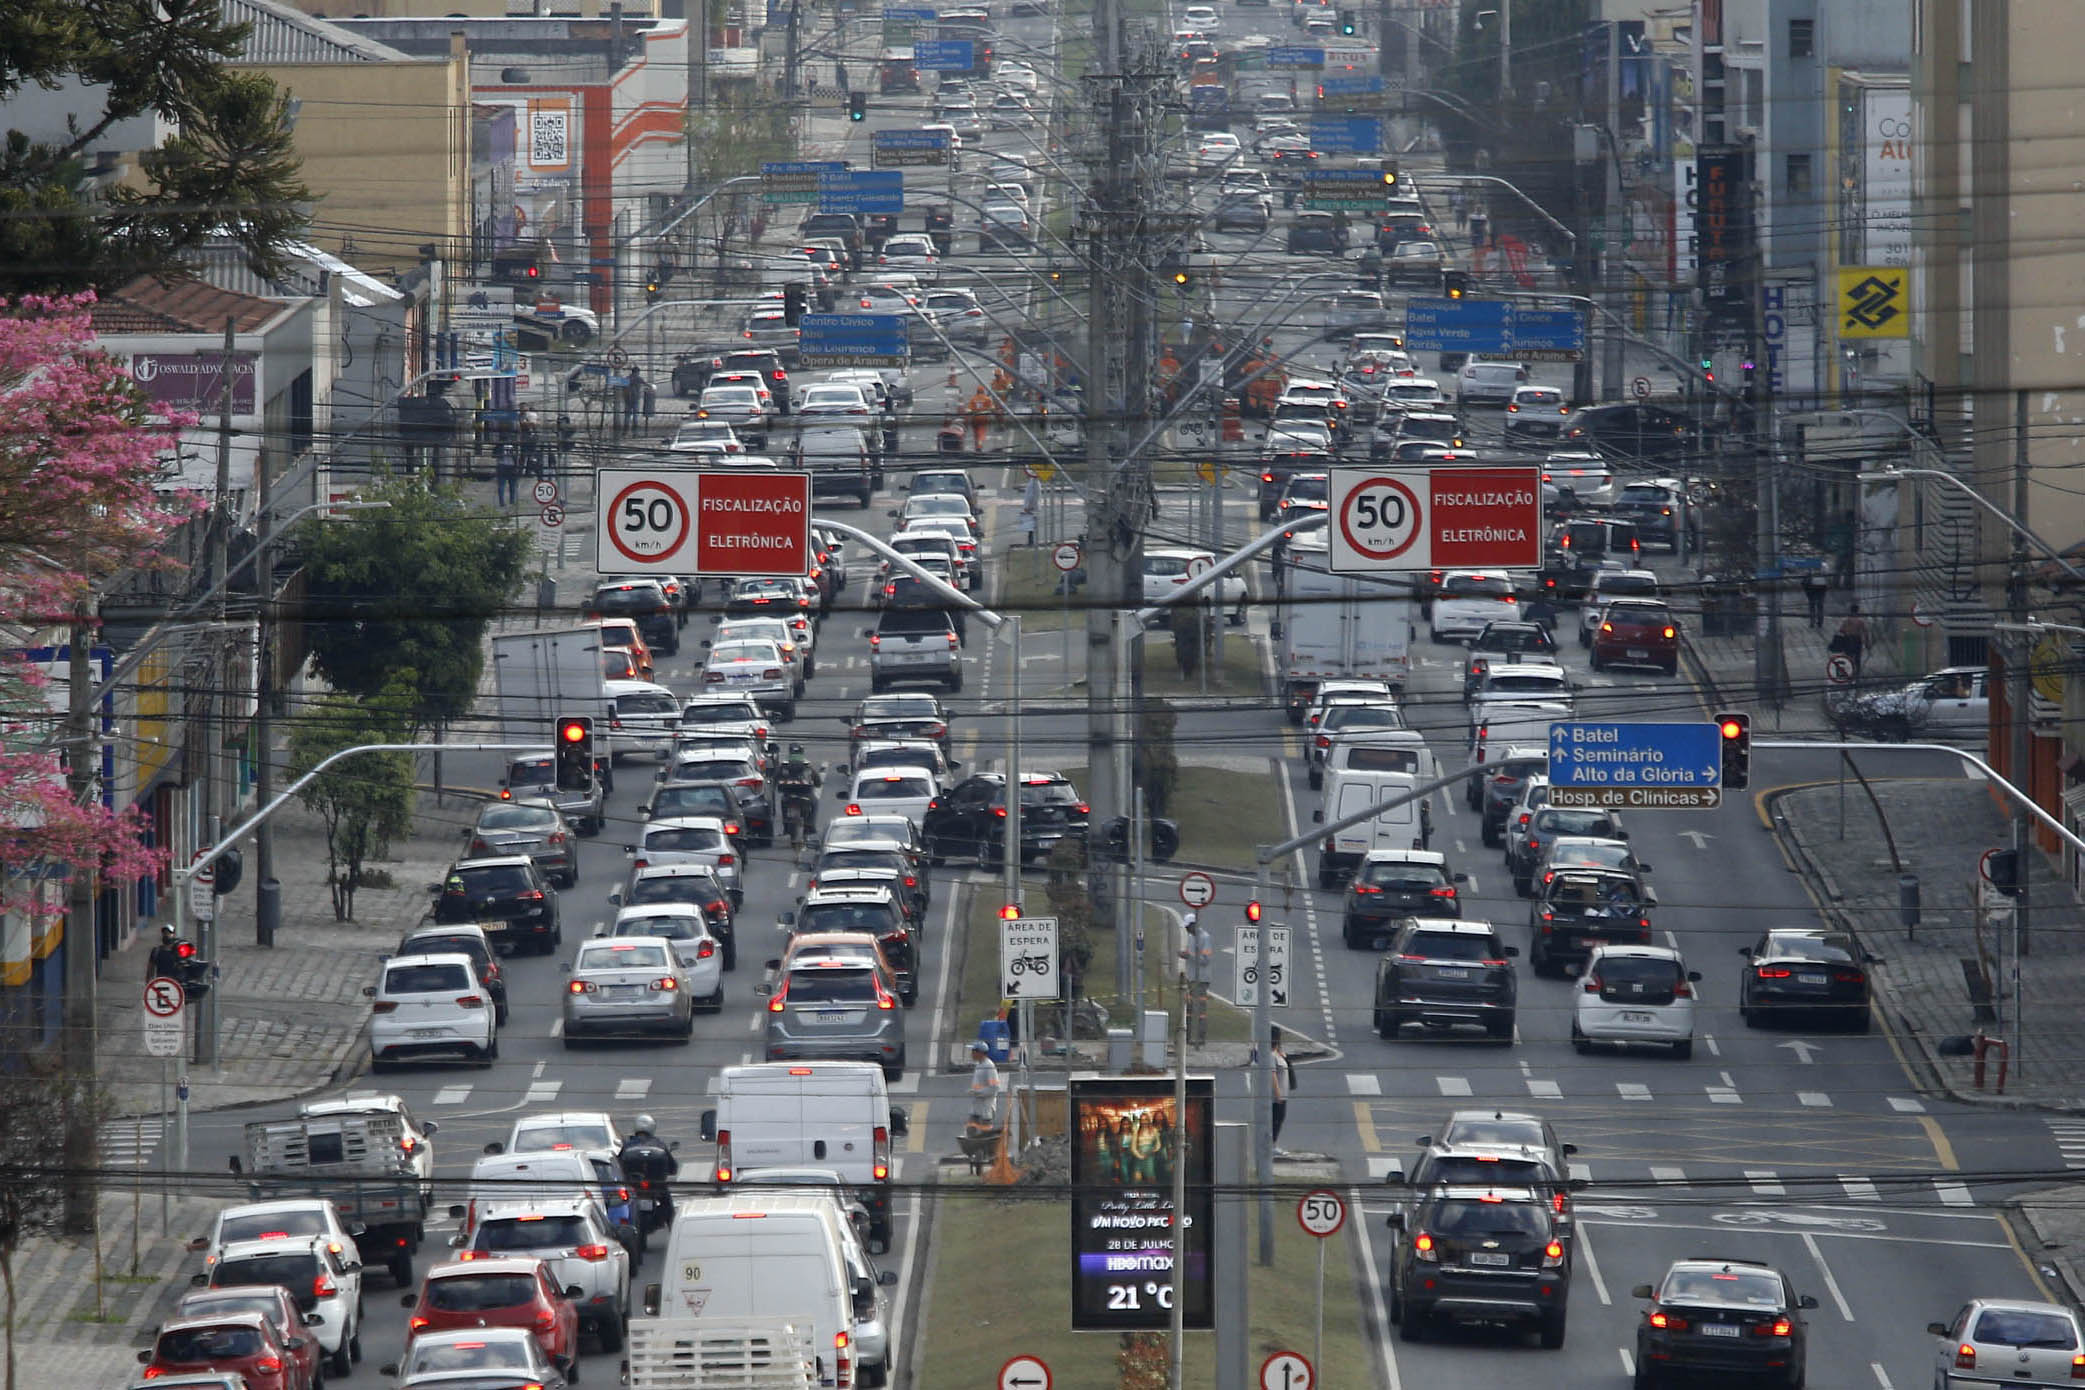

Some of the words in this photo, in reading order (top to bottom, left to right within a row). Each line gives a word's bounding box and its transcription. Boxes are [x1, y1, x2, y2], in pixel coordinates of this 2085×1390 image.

[801, 316, 839, 326] Centro
[1408, 313, 1437, 323] Batel
[1439, 328, 1471, 338] Verde
[160, 364, 198, 375] OSWALD
[199, 364, 254, 375] ADVACIA
[538, 486, 554, 497] 50
[1434, 489, 1534, 508] FISCALIZAÇÃO
[703, 496, 802, 515] FISCALIZAÇÃO
[1357, 495, 1405, 530] 50
[624, 497, 673, 533] 50
[709, 532, 794, 549] ELETRÔNICA
[1367, 537, 1395, 546] km/h
[1441, 526, 1527, 543] ELETRÔNICA
[634, 540, 662, 550] km/h
[1573, 728, 1619, 743] Batel
[1573, 747, 1664, 763] Seminário
[1573, 766, 1608, 782] Alto
[1614, 767, 1636, 782] da
[1642, 767, 1695, 782] Glória
[1603, 789, 1624, 805] de
[1630, 789, 1700, 805] Clínicas
[1008, 921, 1036, 931] ÁREA
[1038, 922, 1052, 931] DE
[1009, 936, 1050, 946] ESPERA
[1273, 932, 1286, 941] DE
[1243, 945, 1284, 954] ESRA
[1307, 1199, 1337, 1221] 50
[1092, 1215, 1111, 1228] UM
[1112, 1215, 1146, 1228] NOVO
[1147, 1215, 1193, 1228] PECO
[1108, 1240, 1121, 1250] 28
[1124, 1240, 1138, 1250] DE
[686, 1266, 701, 1281] 90
[1108, 1284, 1141, 1310] 21
